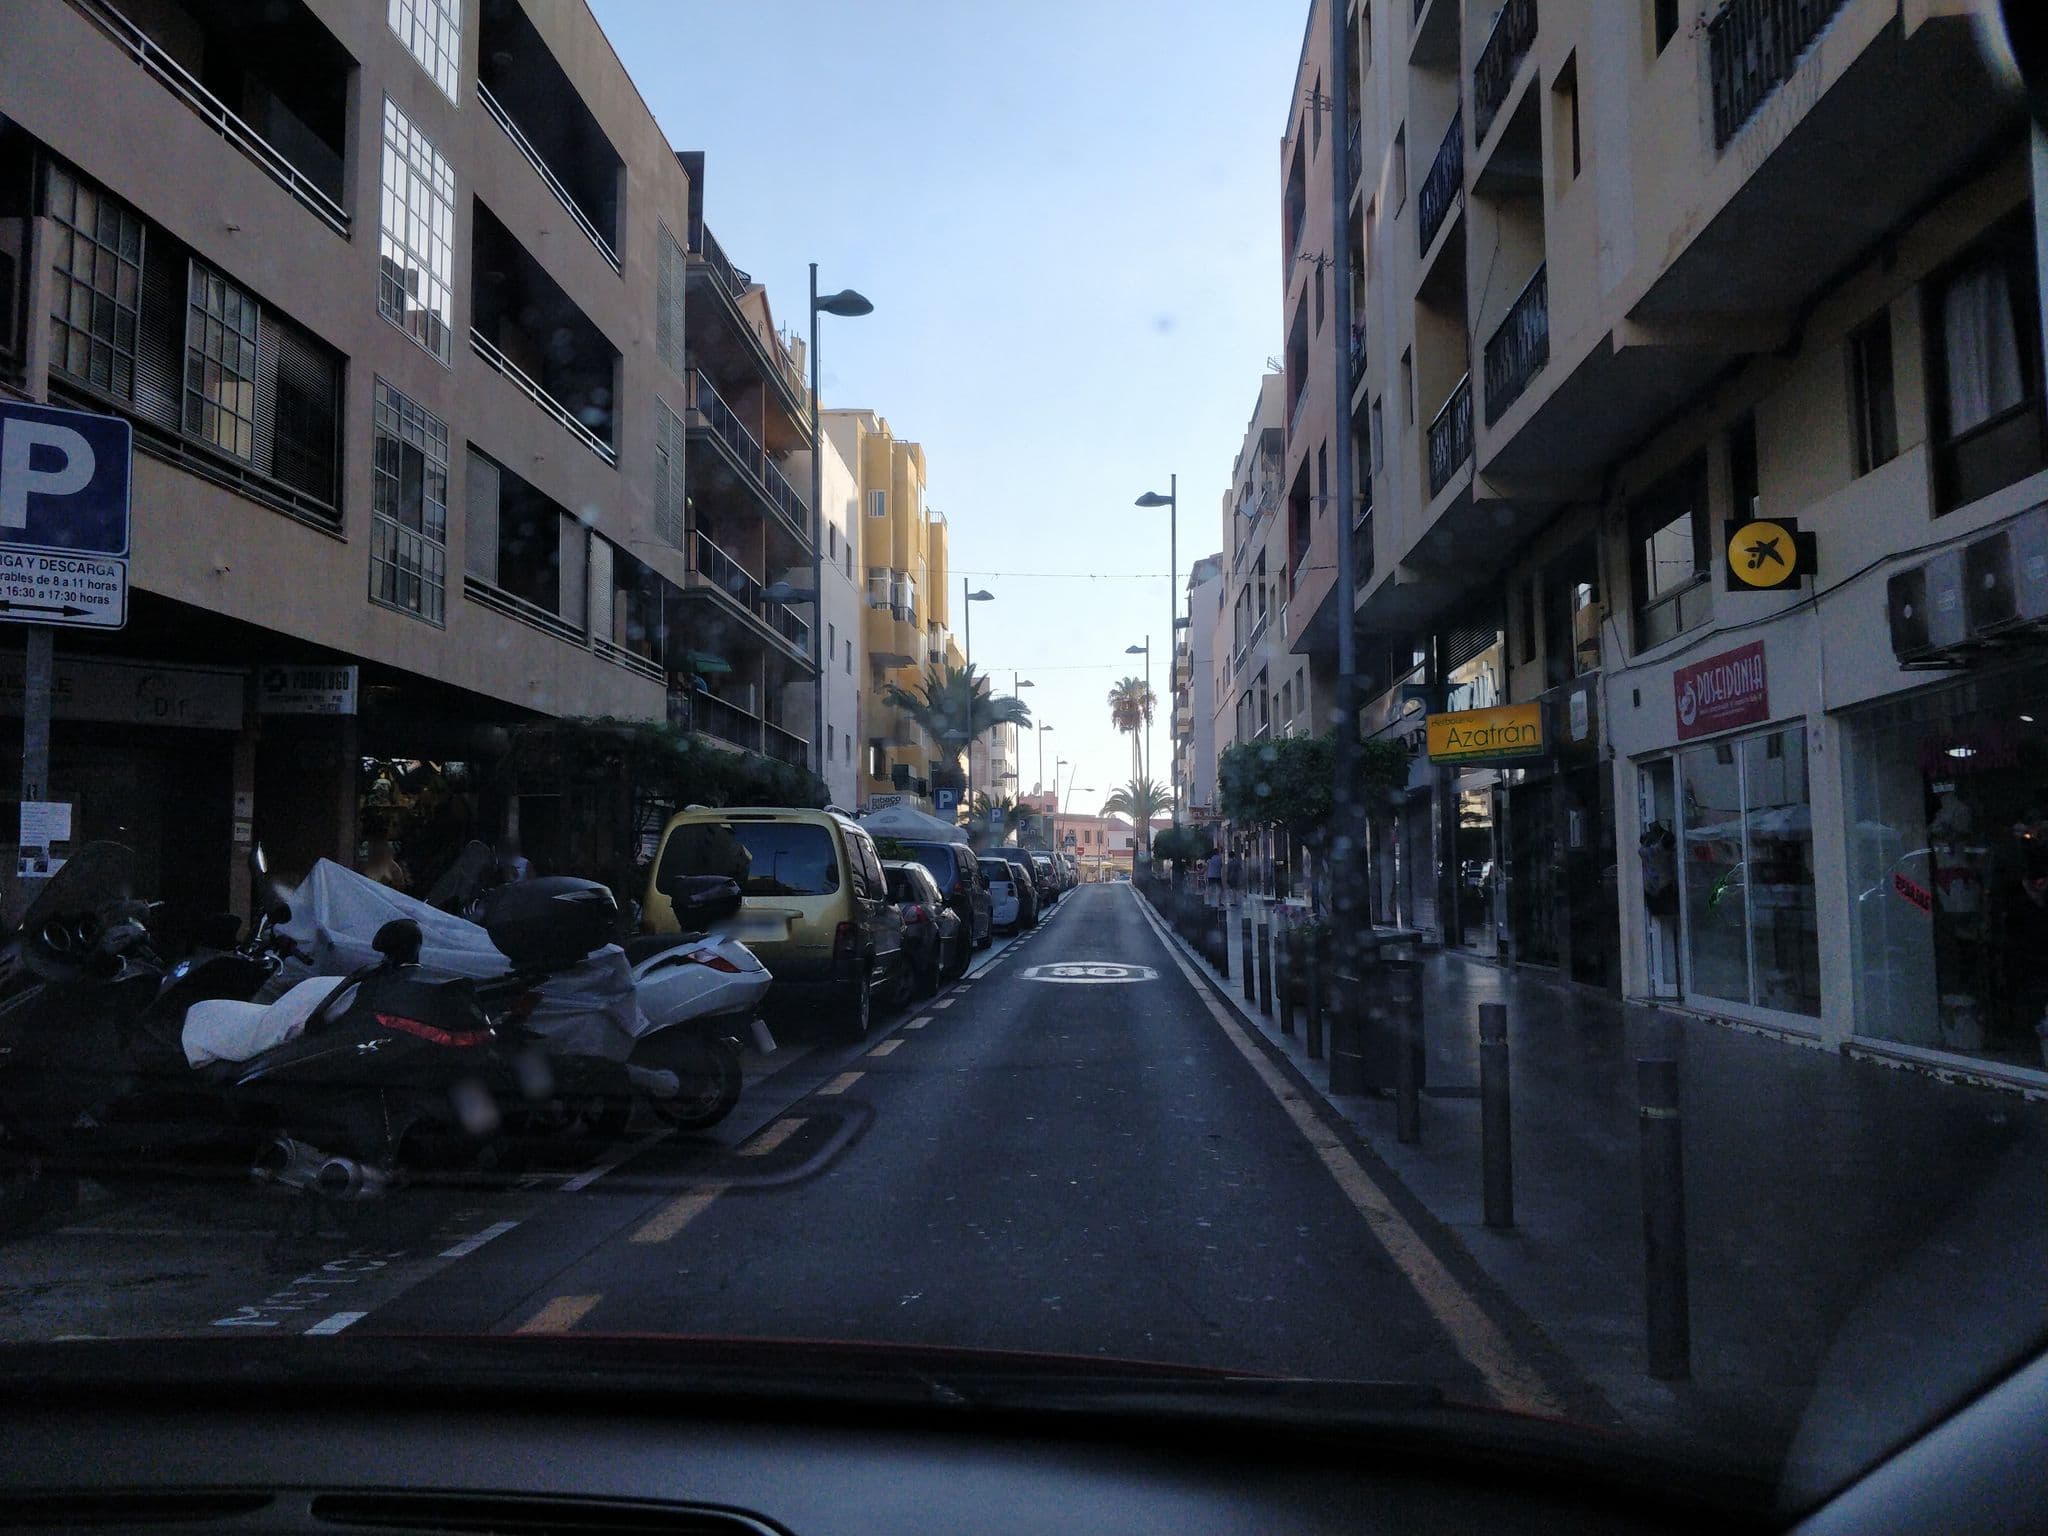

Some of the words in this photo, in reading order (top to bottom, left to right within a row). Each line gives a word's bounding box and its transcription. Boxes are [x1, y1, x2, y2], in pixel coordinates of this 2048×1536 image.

[1, 417, 96, 529] P
[26, 557, 34, 569] Y
[40, 558, 115, 577] DESCARGA
[0, 571, 33, 583] rables
[37, 575, 50, 585] de
[53, 576, 59, 586] 8
[63, 579, 69, 587] a
[73, 579, 83, 588] 11
[88, 580, 117, 591] horas
[7, 586, 35, 598] 16:30
[39, 590, 45, 599] a
[49, 590, 77, 602] 17:30
[80, 593, 110, 605] horas
[1696, 654, 1763, 706] POSEIDONIA
[939, 790, 953, 809] P
[992, 809, 1001, 823] P
